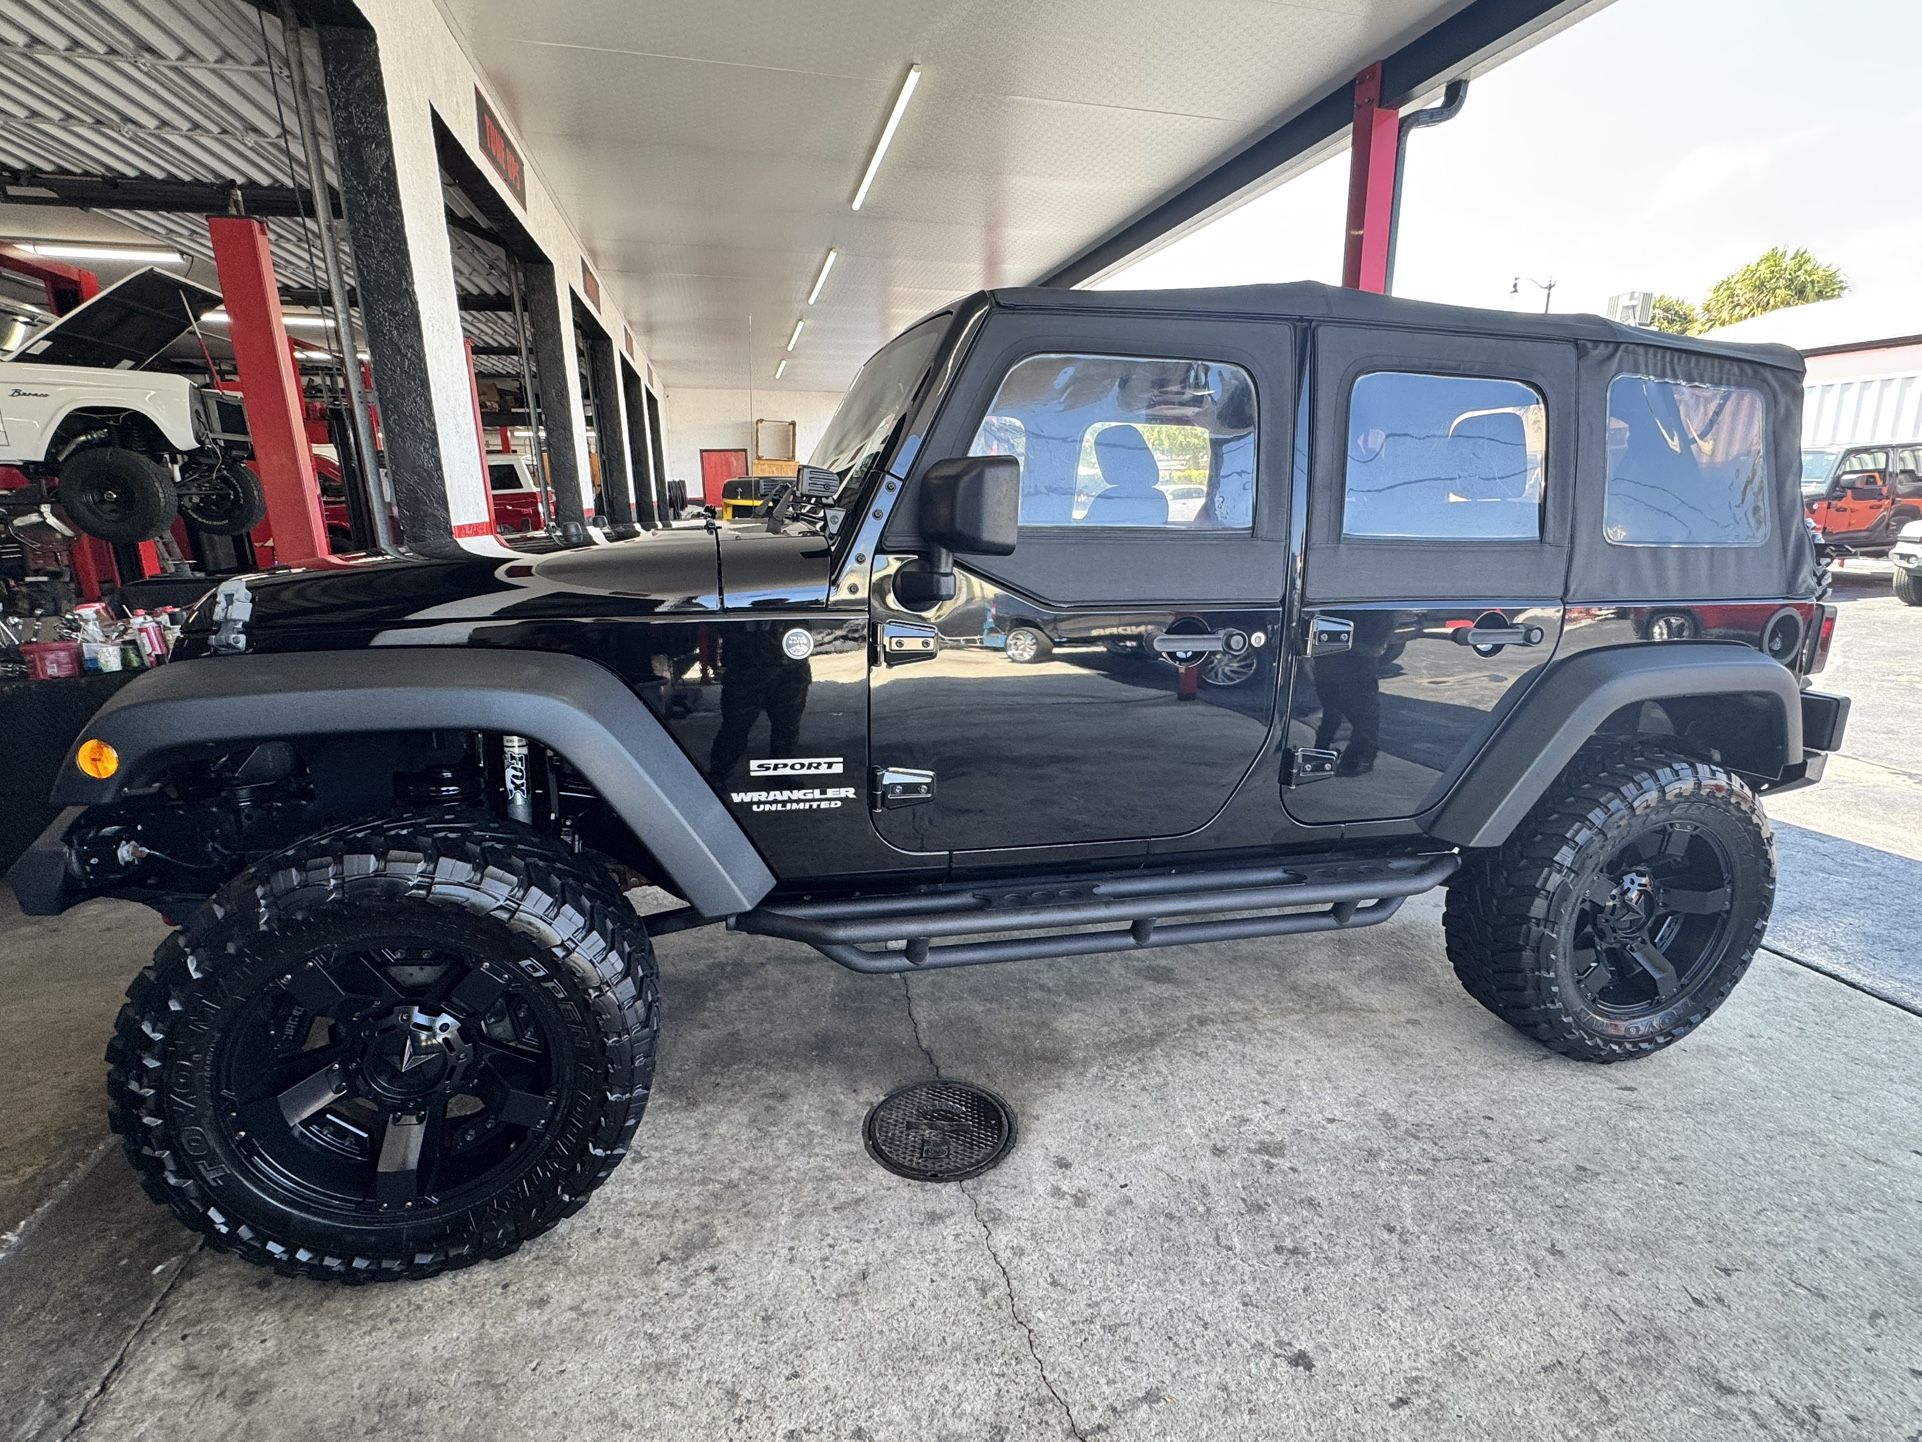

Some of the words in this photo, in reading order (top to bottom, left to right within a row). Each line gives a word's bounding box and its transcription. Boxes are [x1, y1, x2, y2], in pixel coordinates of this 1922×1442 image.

[754, 761, 843, 773] SPORT
[505, 750, 527, 800] FOX
[731, 787, 857, 803] WRANGLER
[752, 800, 842, 812] UNLIMITED
